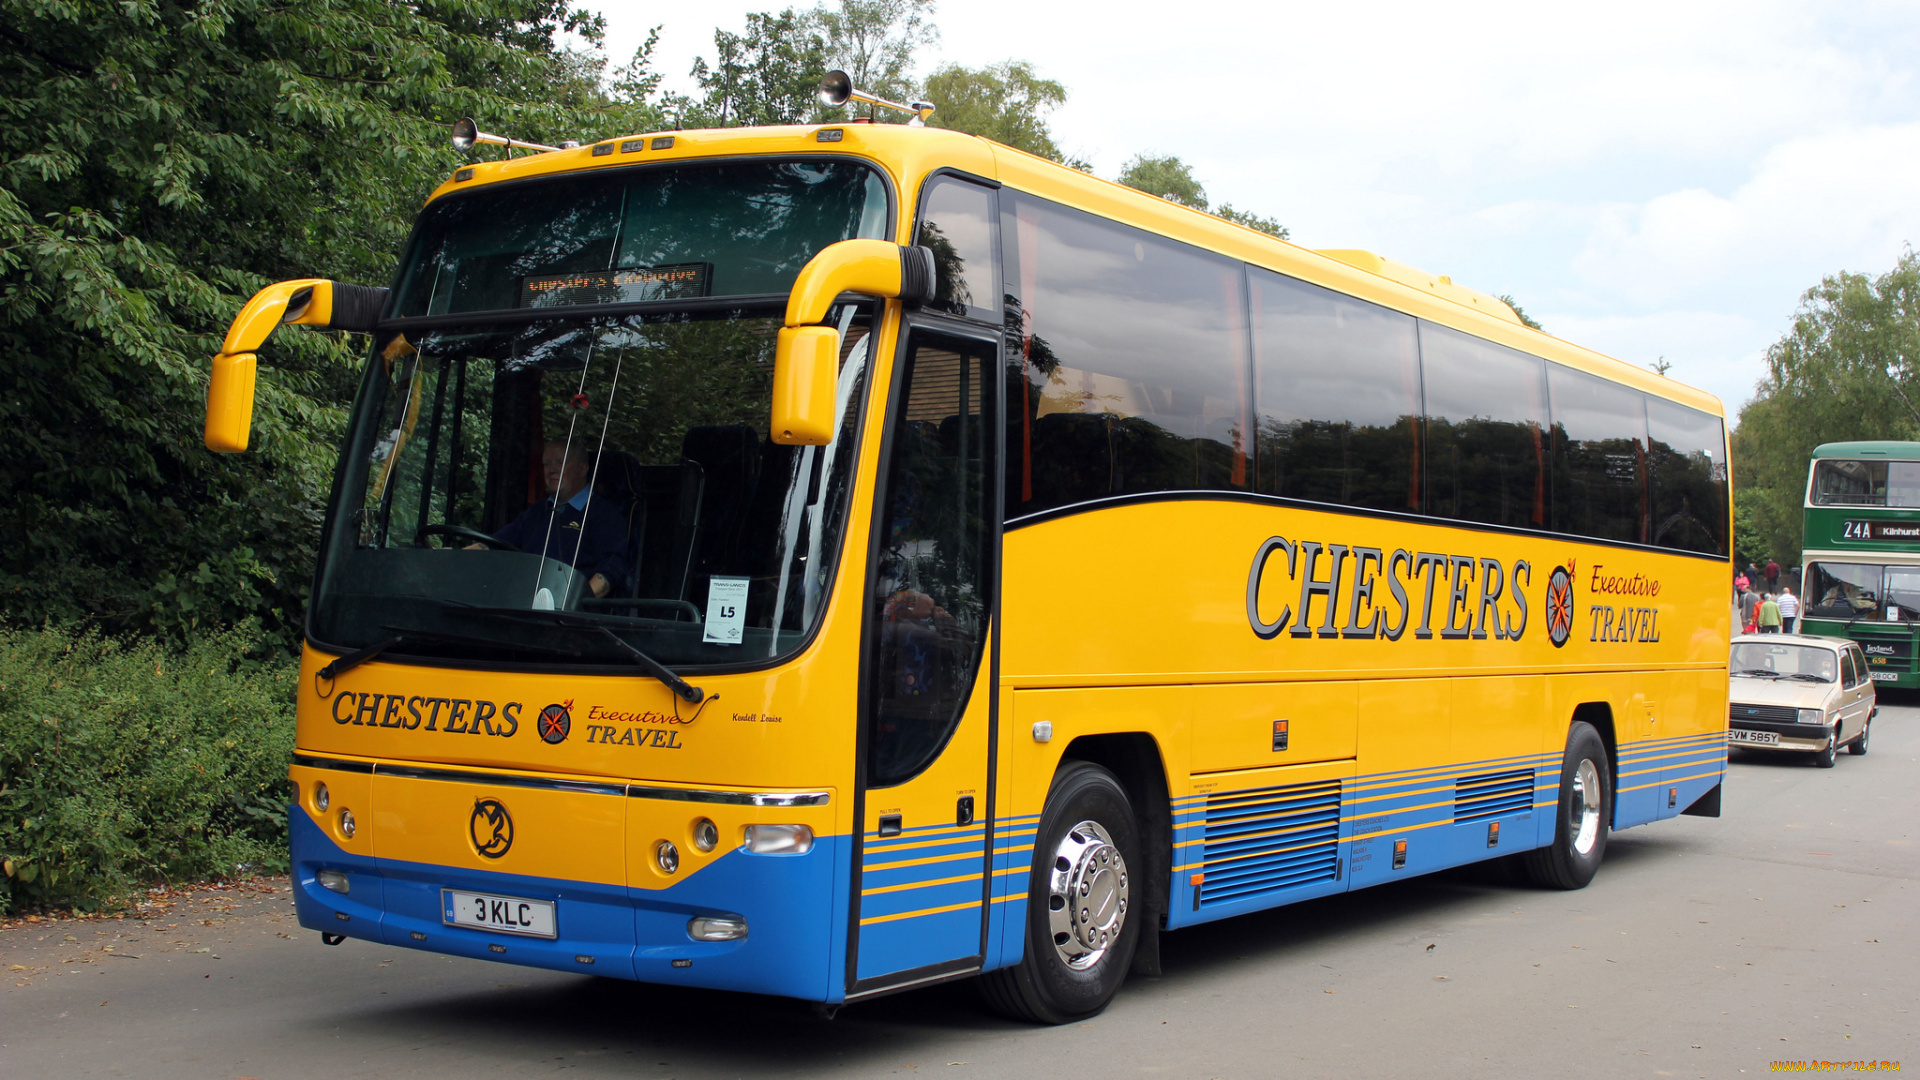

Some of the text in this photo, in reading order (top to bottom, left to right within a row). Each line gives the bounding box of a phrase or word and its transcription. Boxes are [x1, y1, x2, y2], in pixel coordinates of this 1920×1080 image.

[1843, 521, 1920, 538] 24A Kilnhurst
[1246, 535, 1531, 642] CHESTERS
[1590, 564, 1661, 597] Executive
[720, 606, 735, 618] L5
[1590, 605, 1660, 643] TRAVEL
[1866, 644, 1895, 655] Leyland
[1873, 657, 1887, 665] 658
[332, 691, 522, 737] CHESTERS
[588, 706, 683, 725] Executive
[760, 713, 783, 723] Louise
[586, 725, 682, 749] TRAVEL
[1750, 732, 1778, 743] 585Y
[475, 898, 531, 926] 3 KLC
